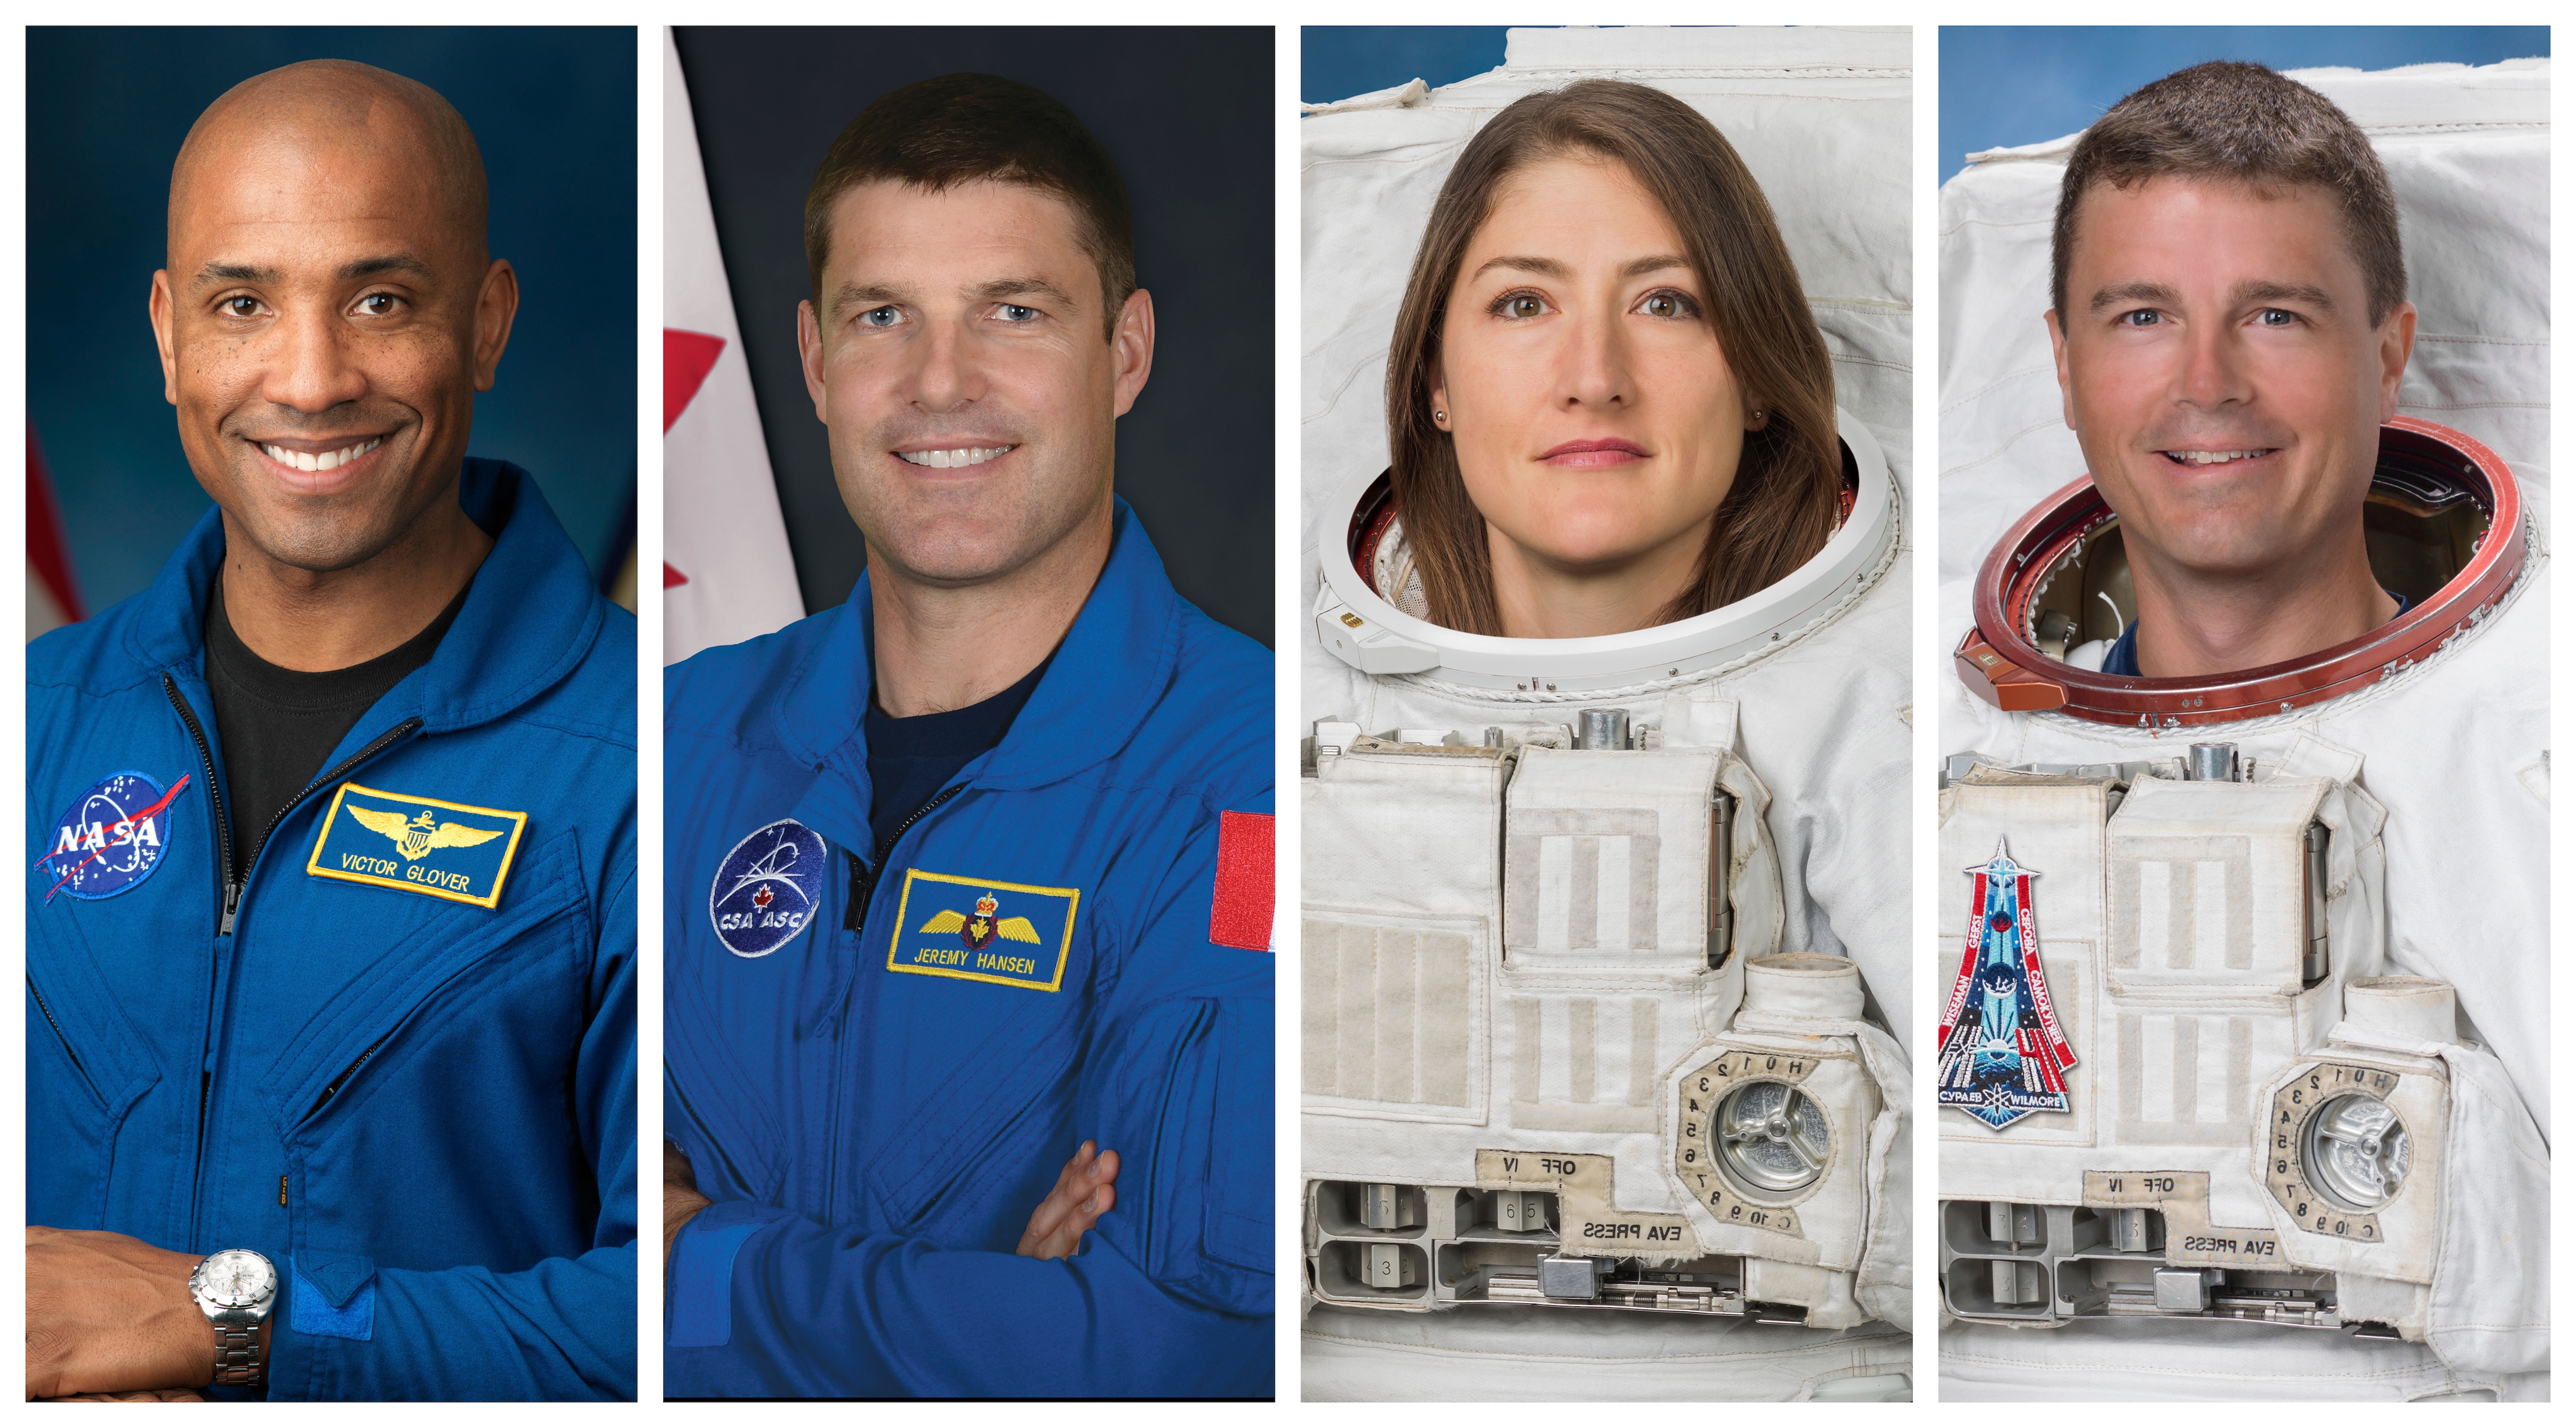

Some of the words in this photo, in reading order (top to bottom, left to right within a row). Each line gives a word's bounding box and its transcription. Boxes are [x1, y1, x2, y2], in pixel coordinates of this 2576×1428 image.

[55, 817, 161, 855] NASA
[343, 853, 397, 876] VICTOR
[406, 865, 470, 892] GLOVER
[720, 912, 753, 930] CSA
[759, 911, 803, 928] ASC
[914, 948, 969, 966] JEREMY
[977, 953, 1035, 975] HANSEN
[1942, 975, 1970, 1027] WISEMAN
[1969, 914, 1982, 949] GERST
[2021, 908, 2035, 956] СЕРОВА
[2030, 970, 2063, 1046] САМОКУТЯЕВ
[1939, 1091, 1982, 1102] СУРАЕВ
[2011, 1094, 2060, 1107] WILMORE
[1378, 1199, 1389, 1216] 5
[1506, 1204, 1515, 1219] 6
[1528, 1203, 1536, 1218] 5
[2128, 1223, 2138, 1239] 3
[1382, 1261, 1391, 1275] 3
[1402, 1259, 1408, 1274] 2
